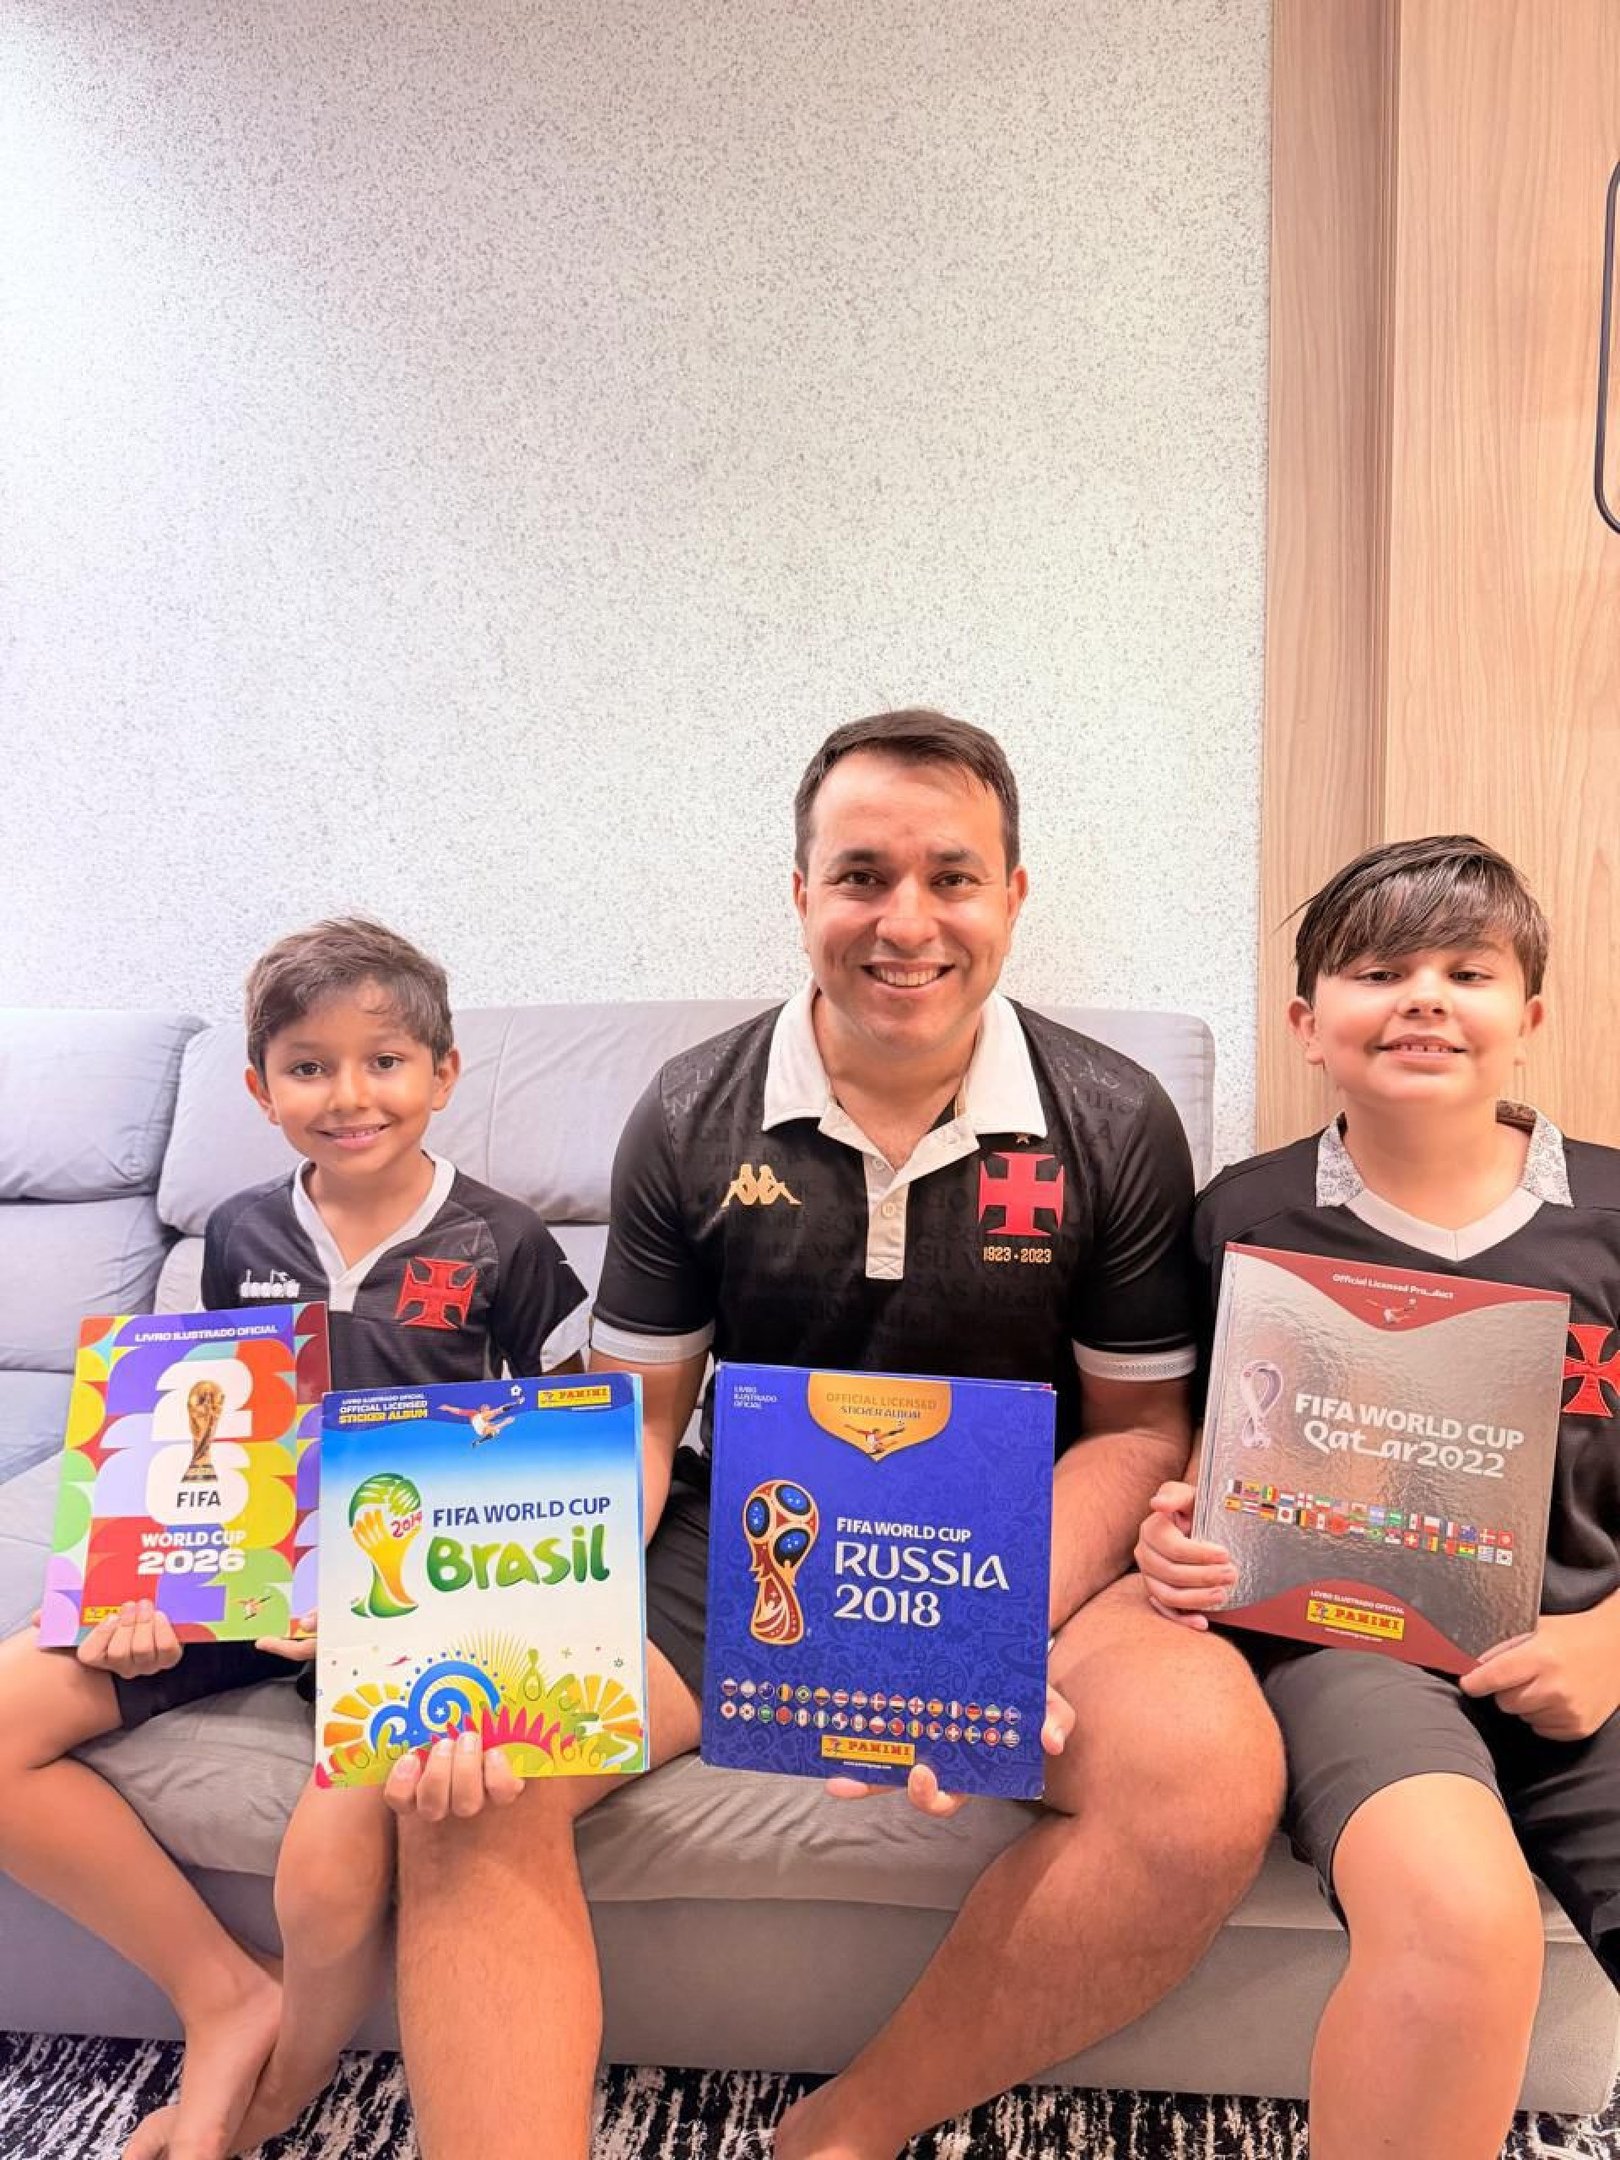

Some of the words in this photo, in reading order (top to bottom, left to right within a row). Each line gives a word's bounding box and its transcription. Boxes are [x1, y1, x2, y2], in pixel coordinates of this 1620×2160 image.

[983, 1246, 1011, 1262] 1923
[1020, 1248, 1052, 1264] 2023
[1332, 1273, 1367, 1287] Official
[1368, 1278, 1409, 1292] Licensed
[134, 1332, 171, 1342] LIVRO
[173, 1327, 236, 1341] ILUSTRADO
[237, 1324, 278, 1337] OFICIAL
[560, 1388, 607, 1400] PANINI
[826, 1391, 879, 1406] OFFICIAL
[881, 1397, 938, 1411] LICENSED
[338, 1412, 386, 1425] STICKER
[388, 1408, 428, 1420] ALBUM
[340, 1403, 381, 1414] OFFICIAL
[382, 1400, 428, 1411] LICENSED
[840, 1405, 882, 1417] STICKER
[1294, 1393, 1355, 1424] FIFA
[1358, 1403, 1462, 1441] WORLD
[1467, 1423, 1525, 1452] CUP
[176, 1490, 222, 1508] FIFA
[432, 1506, 480, 1528] FIFA
[483, 1501, 565, 1524] WORLD
[569, 1496, 611, 1516] CUP
[140, 1531, 209, 1548] WORLD
[211, 1529, 247, 1546] CUP
[836, 1516, 873, 1536] FIFA
[874, 1521, 936, 1541] WORLD
[938, 1526, 971, 1544] CUP
[137, 1547, 247, 1576] 2026
[426, 1523, 610, 1592] Brasil
[834, 1540, 1010, 1591] RUSSIA
[833, 1583, 941, 1628] 2018
[1335, 1607, 1399, 1631] PANINI
[848, 1740, 910, 1756] PANINI
